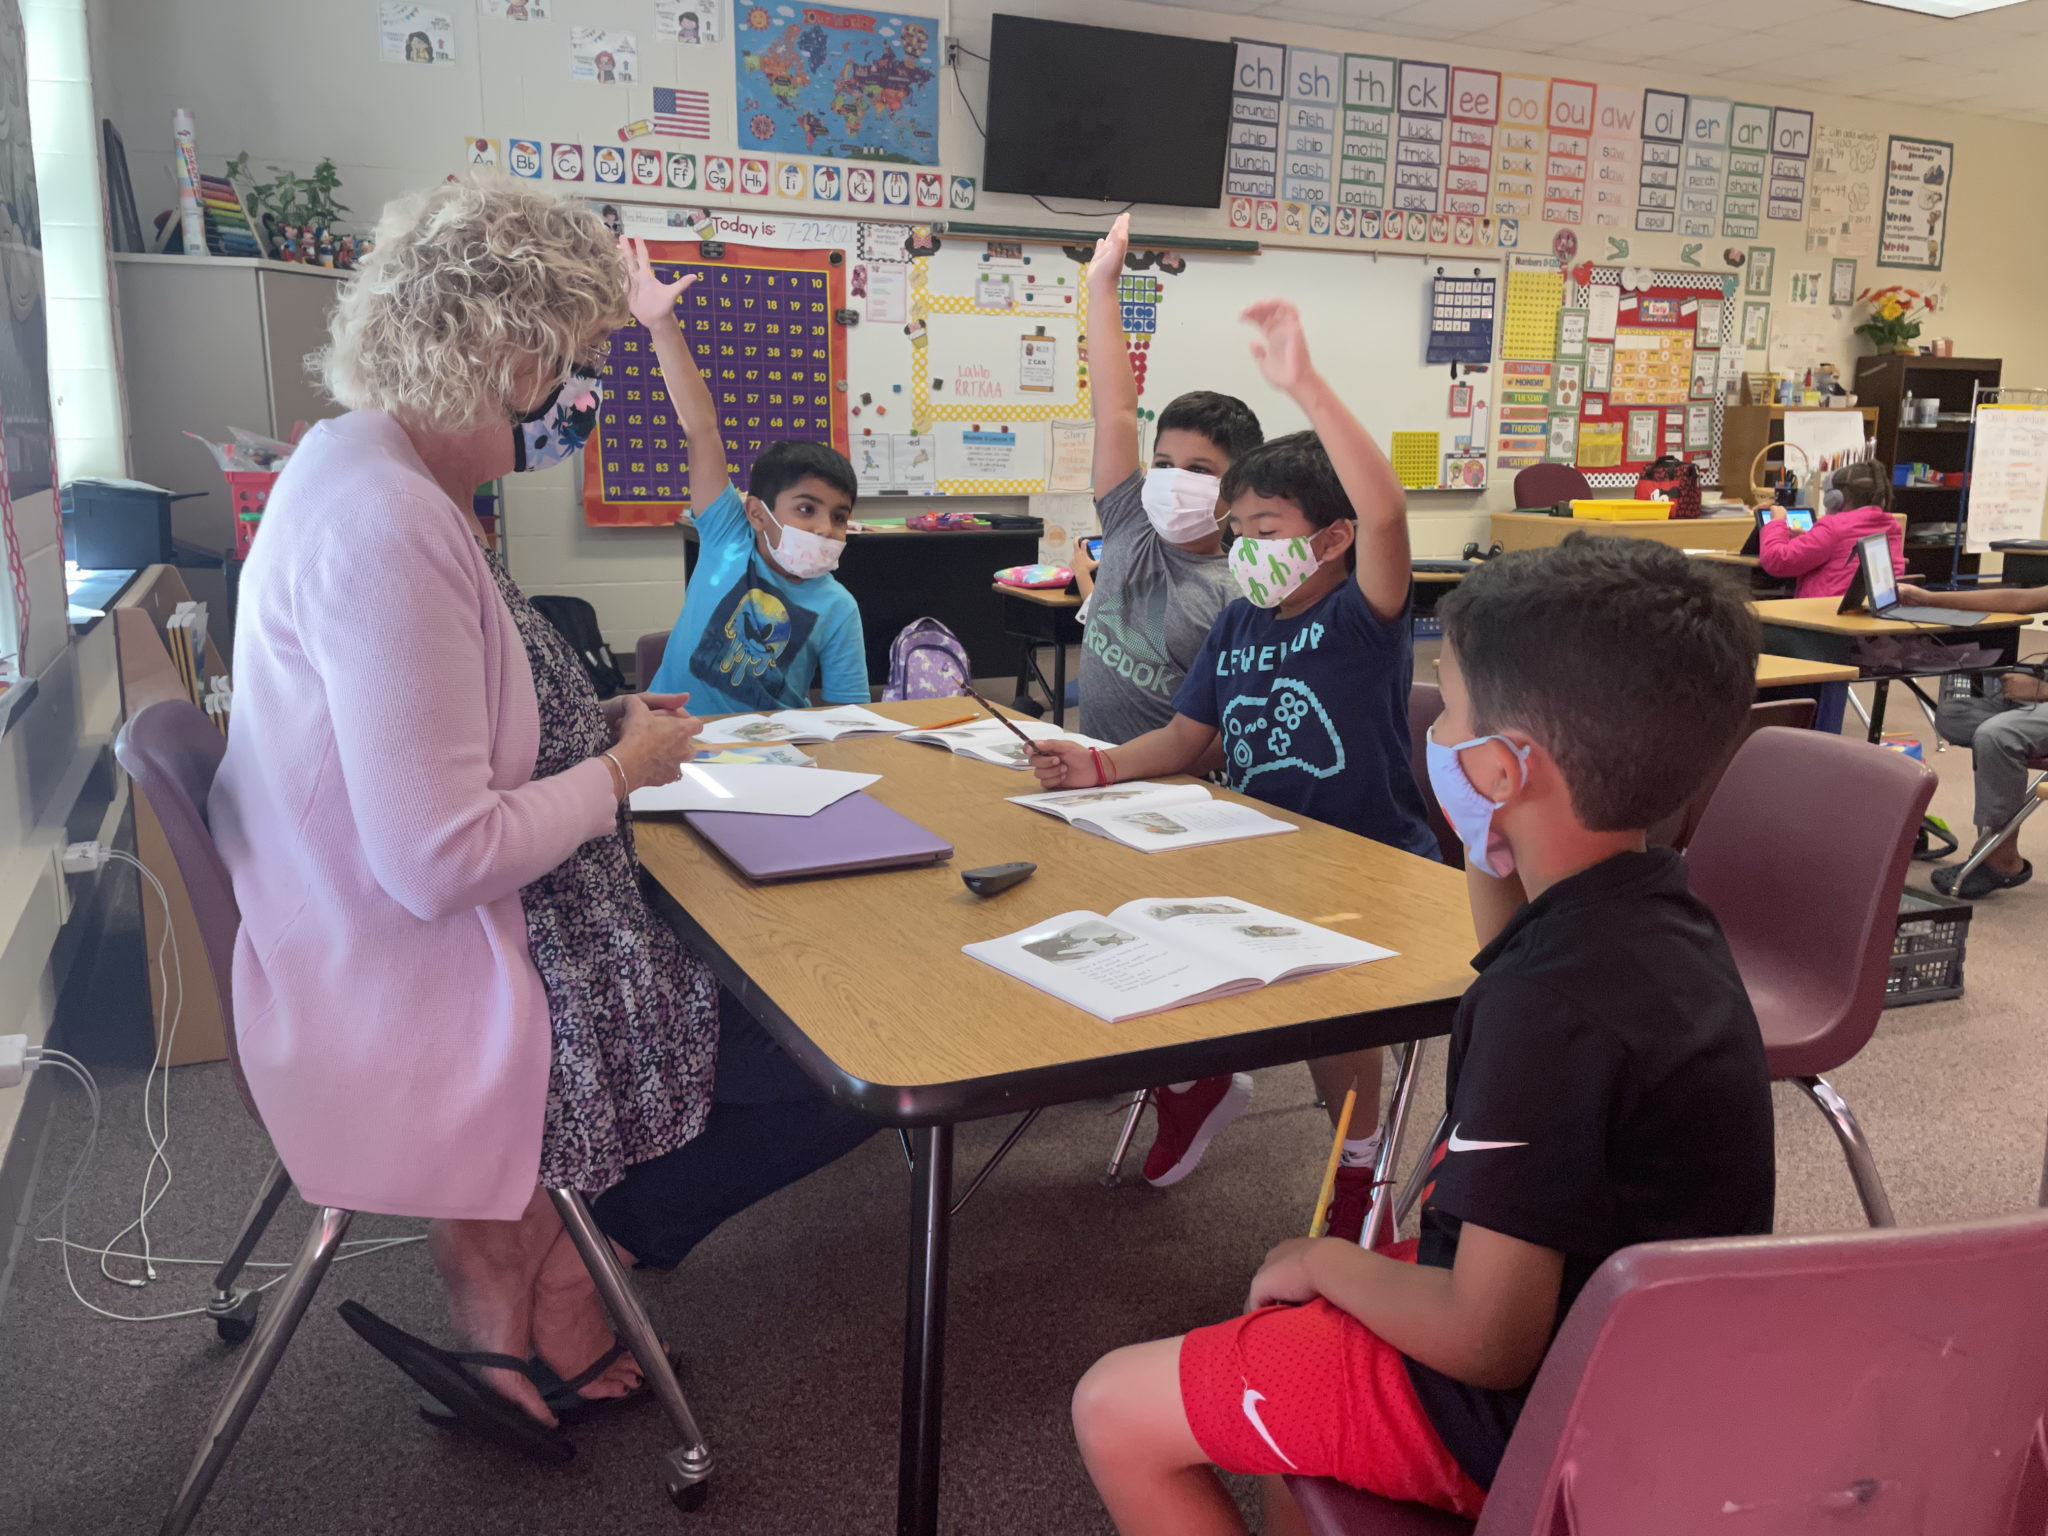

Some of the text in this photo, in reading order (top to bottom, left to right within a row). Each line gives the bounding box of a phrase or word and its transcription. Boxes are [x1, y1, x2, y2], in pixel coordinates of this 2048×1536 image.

[1240, 58, 1272, 90] ch
[1298, 66, 1330, 98] sh
[1354, 69, 1384, 102] th
[1408, 78, 1438, 108] ck
[1460, 92, 1489, 114] ee
[1508, 98, 1538, 120] oo
[1234, 104, 1276, 120] crunch
[1298, 110, 1324, 128] fish
[1556, 103, 1584, 124] ou
[1601, 108, 1636, 130] aw
[1352, 116, 1382, 133] thud
[1655, 109, 1673, 134] oi
[1695, 117, 1720, 139] er
[1240, 128, 1266, 146] chip
[1408, 122, 1433, 140] luck
[1458, 126, 1486, 144] tree
[1738, 122, 1762, 145] ar
[1780, 127, 1804, 150] or
[1297, 136, 1322, 152] ship
[1347, 142, 1384, 159] moth
[517, 155, 535, 170] Bb
[1235, 152, 1270, 171] lunch
[1403, 146, 1434, 164] trick
[1458, 151, 1480, 168] bee
[559, 159, 577, 173] Cc
[600, 162, 618, 175] Dd
[638, 164, 652, 177] Ee
[1292, 162, 1324, 178] cash
[1351, 165, 1376, 182] thin
[674, 168, 688, 181] Ff
[709, 170, 726, 189] Gg
[745, 174, 761, 187] Hh
[1401, 169, 1433, 187] brick
[786, 176, 796, 190] Ii
[819, 180, 831, 198] Jj
[854, 182, 867, 195] Kk
[891, 185, 900, 197] Ll
[1230, 180, 1274, 196] munch
[1456, 178, 1478, 192] see
[920, 188, 938, 200] Mm
[955, 190, 970, 203] Nn
[1292, 184, 1323, 200] shop
[1346, 190, 1377, 205] path
[1890, 186, 1914, 197] Draw
[1403, 196, 1427, 210] sick
[1450, 198, 1480, 214] keep
[712, 216, 776, 239] Today is:
[673, 271, 822, 288] 4 5 6 7 8 9 10
[696, 296, 824, 312] 15 16 17 18 19 20
[696, 320, 824, 336] 25 26 27 28 29 30
[624, 342, 826, 359] 32 35 36 37 38 39 40
[602, 365, 826, 382] 41 42 46 47 48 49 50
[1516, 363, 1546, 372] SUNDAY
[955, 379, 1002, 399] RRTKAA
[1515, 378, 1544, 386] MONDAY
[603, 390, 827, 405] 51 52 53 56 57 58 59 60
[1514, 393, 1543, 402] TUESDAY
[605, 414, 828, 428] 61 62 63 66 67 68 69 70
[1512, 424, 1542, 433] THURSDAY
[606, 438, 761, 450] 71 72 73 76 77
[907, 437, 920, 446] -ed
[608, 462, 669, 472] 81 82 83
[610, 486, 671, 496] 91 92 93
[1291, 622, 1324, 652] UP
